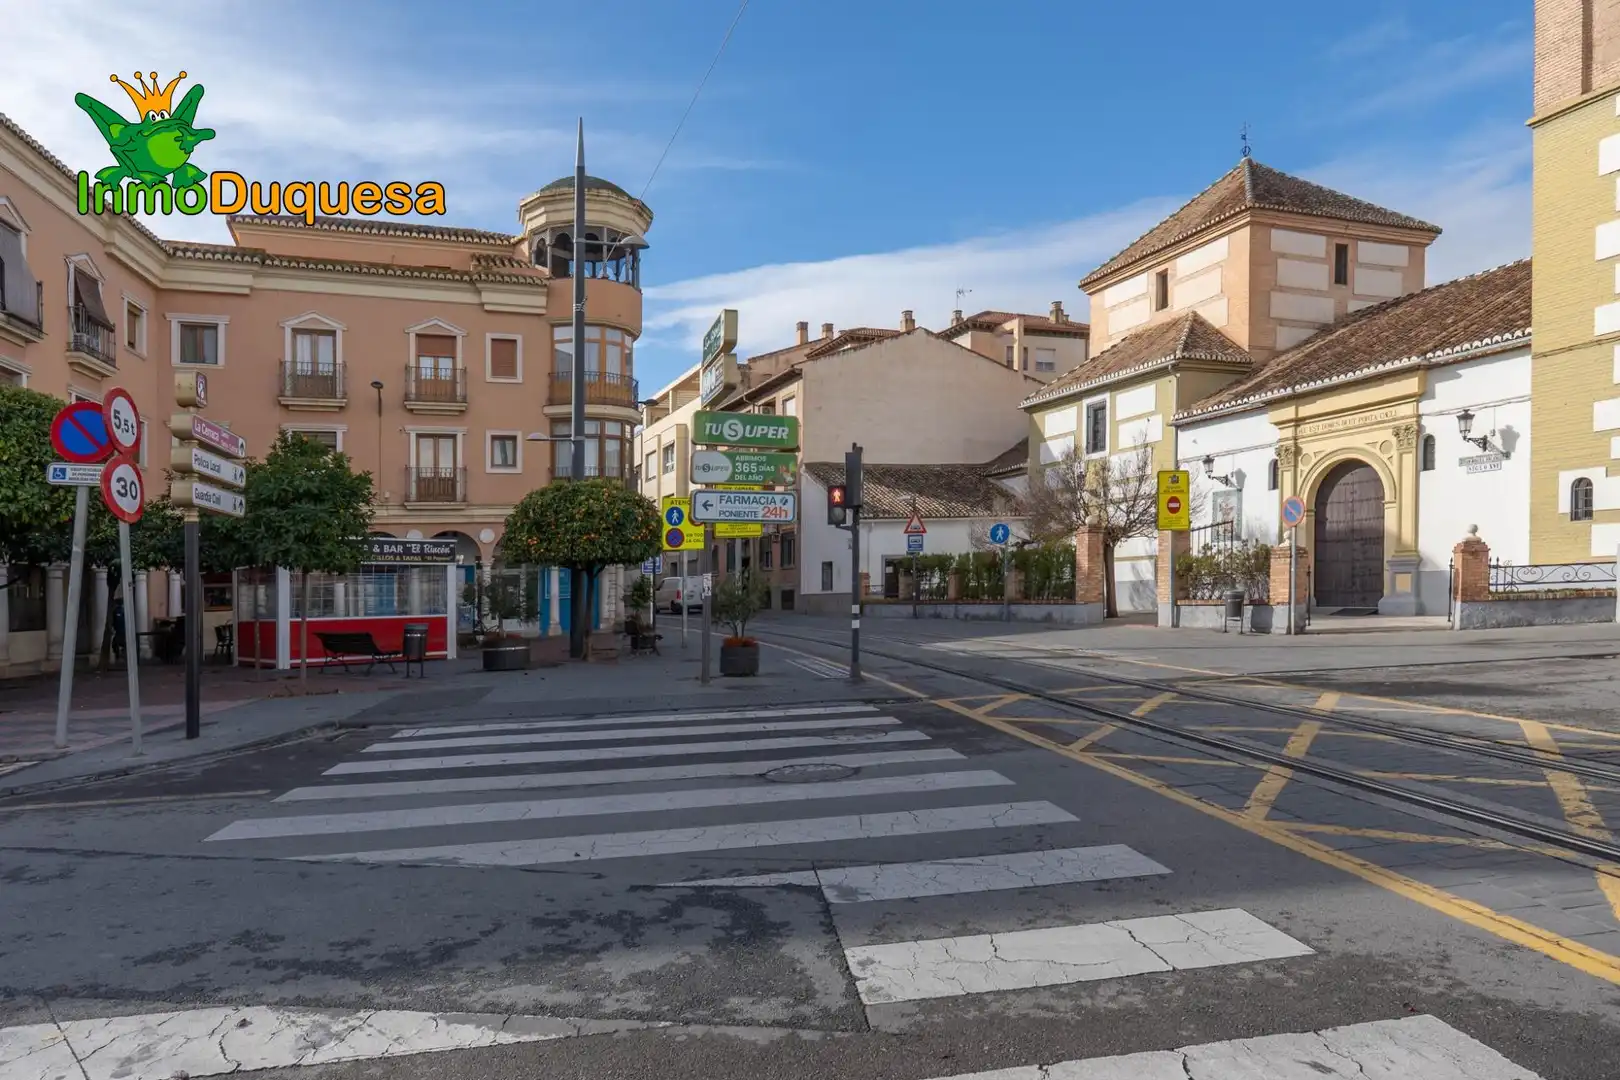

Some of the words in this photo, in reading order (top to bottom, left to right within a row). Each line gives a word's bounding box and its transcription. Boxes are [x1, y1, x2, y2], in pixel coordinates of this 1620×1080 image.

[114, 409, 129, 434] 5,5
[735, 463, 758, 473] 365
[758, 464, 775, 472] DÍAS
[748, 473, 764, 481] AÑO
[116, 477, 138, 500] 30
[195, 487, 211, 503] Guardia
[719, 495, 777, 505] FARMACIA
[719, 510, 759, 518] PONIENTE
[761, 506, 788, 519] 24h
[383, 544, 404, 553] BAR
